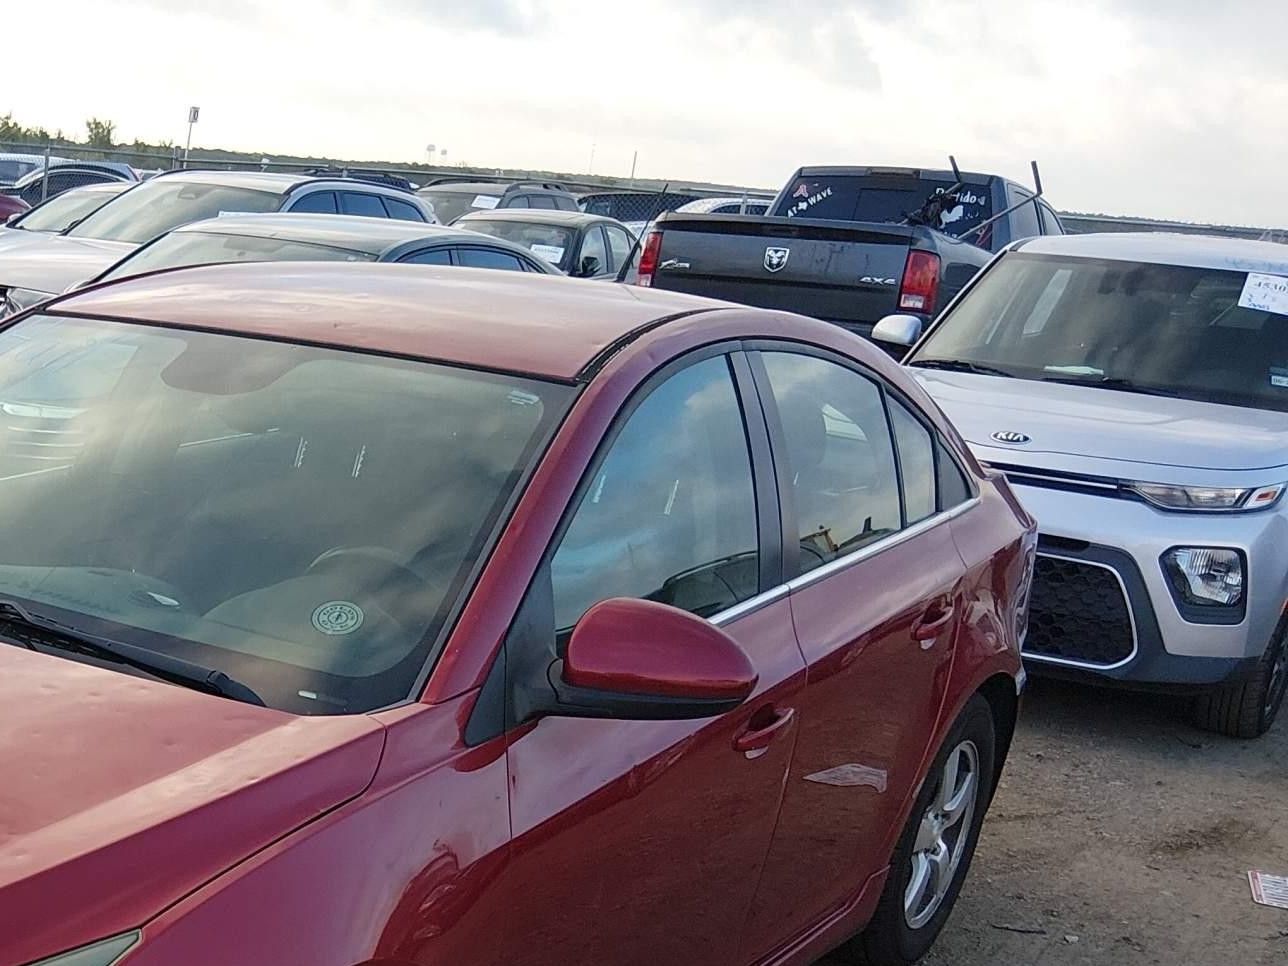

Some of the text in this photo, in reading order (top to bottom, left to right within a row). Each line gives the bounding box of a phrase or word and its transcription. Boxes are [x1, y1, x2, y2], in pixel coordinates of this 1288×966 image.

[807, 187, 833, 206] WAVE
[935, 187, 977, 204] Ptido
[996, 432, 1024, 441] KIA
